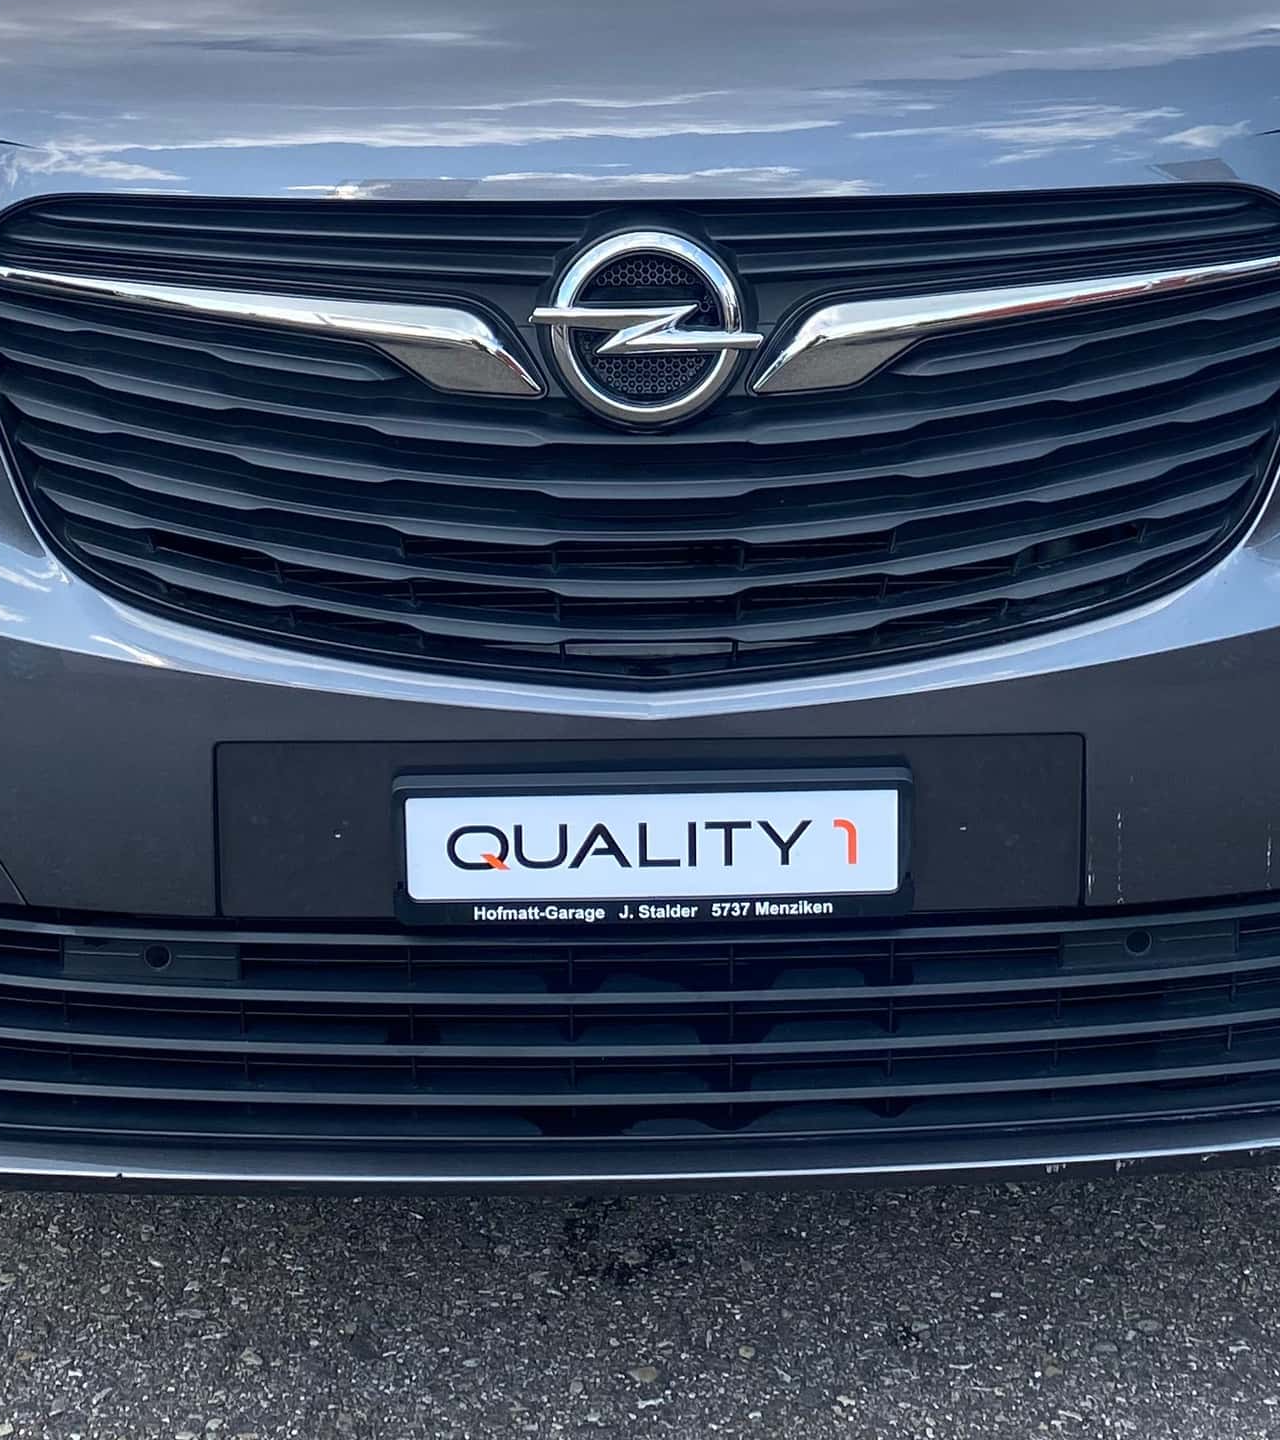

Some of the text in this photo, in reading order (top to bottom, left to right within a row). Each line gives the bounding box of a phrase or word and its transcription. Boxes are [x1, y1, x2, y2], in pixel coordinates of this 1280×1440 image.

[446, 818, 857, 871] QUALITY 1
[473, 901, 834, 922] Hofmatt-Garage J. Stalder 5737 Menziken
